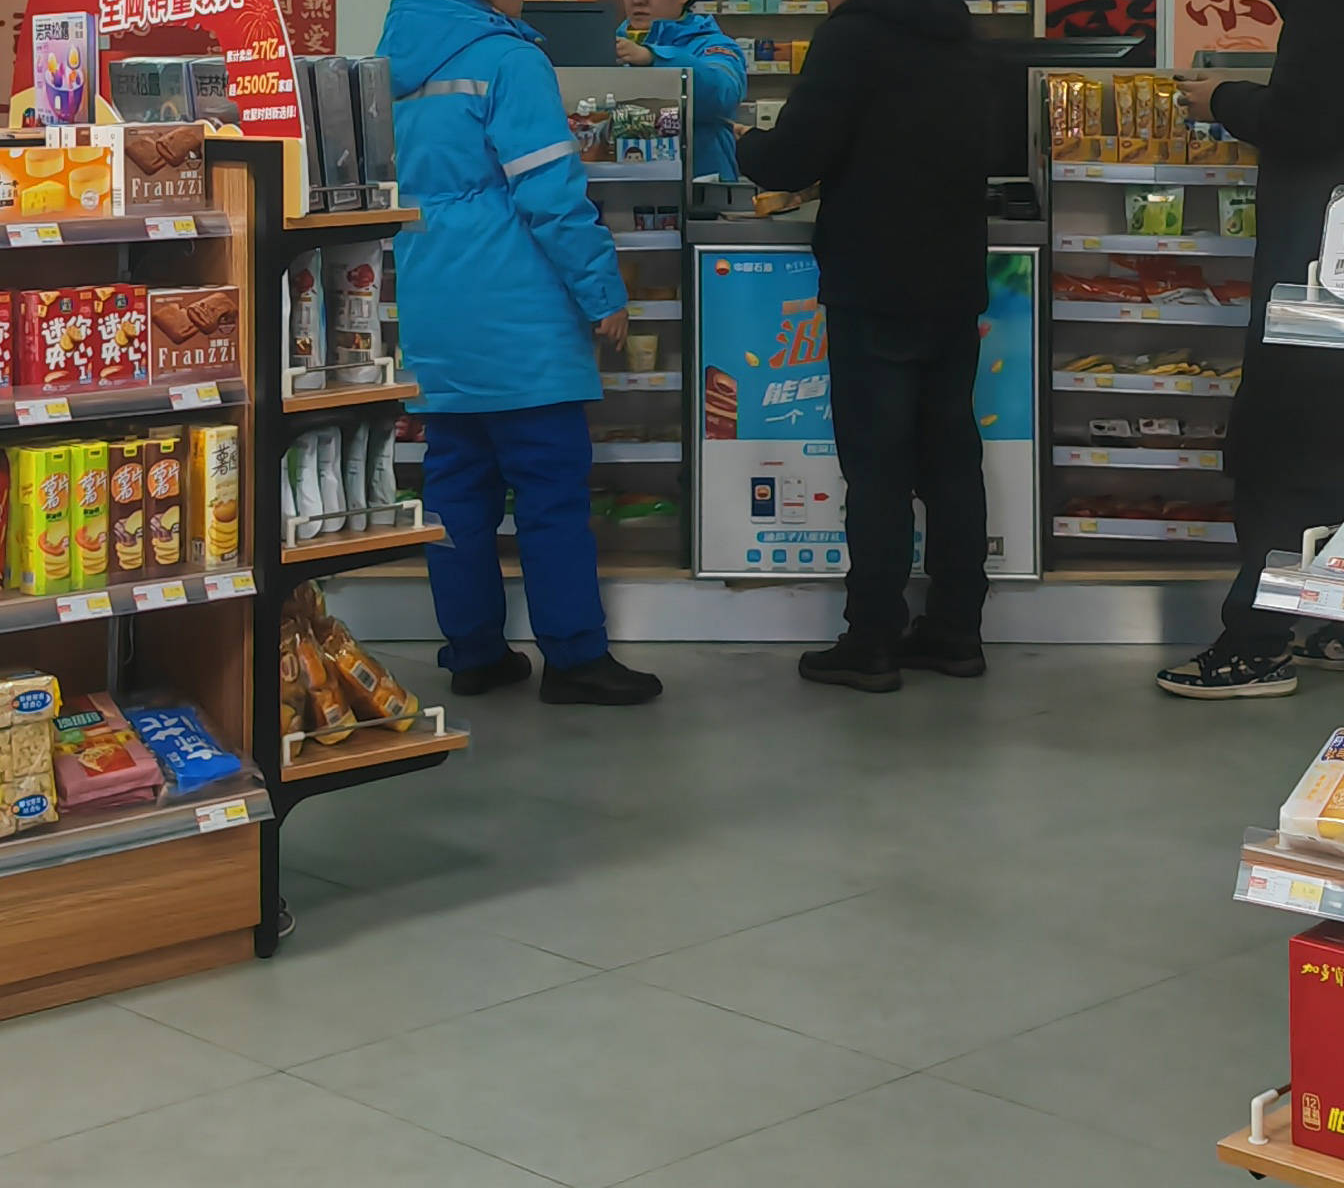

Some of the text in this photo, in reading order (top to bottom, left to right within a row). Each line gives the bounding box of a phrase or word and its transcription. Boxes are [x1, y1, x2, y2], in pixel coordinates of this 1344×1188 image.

[131, 176, 203, 199] Franzzi
[42, 314, 92, 346] 迷你
[98, 310, 146, 341] 迷你
[45, 342, 93, 370] 夹心
[101, 338, 146, 364] 夹心
[158, 342, 236, 368] Franzzi
